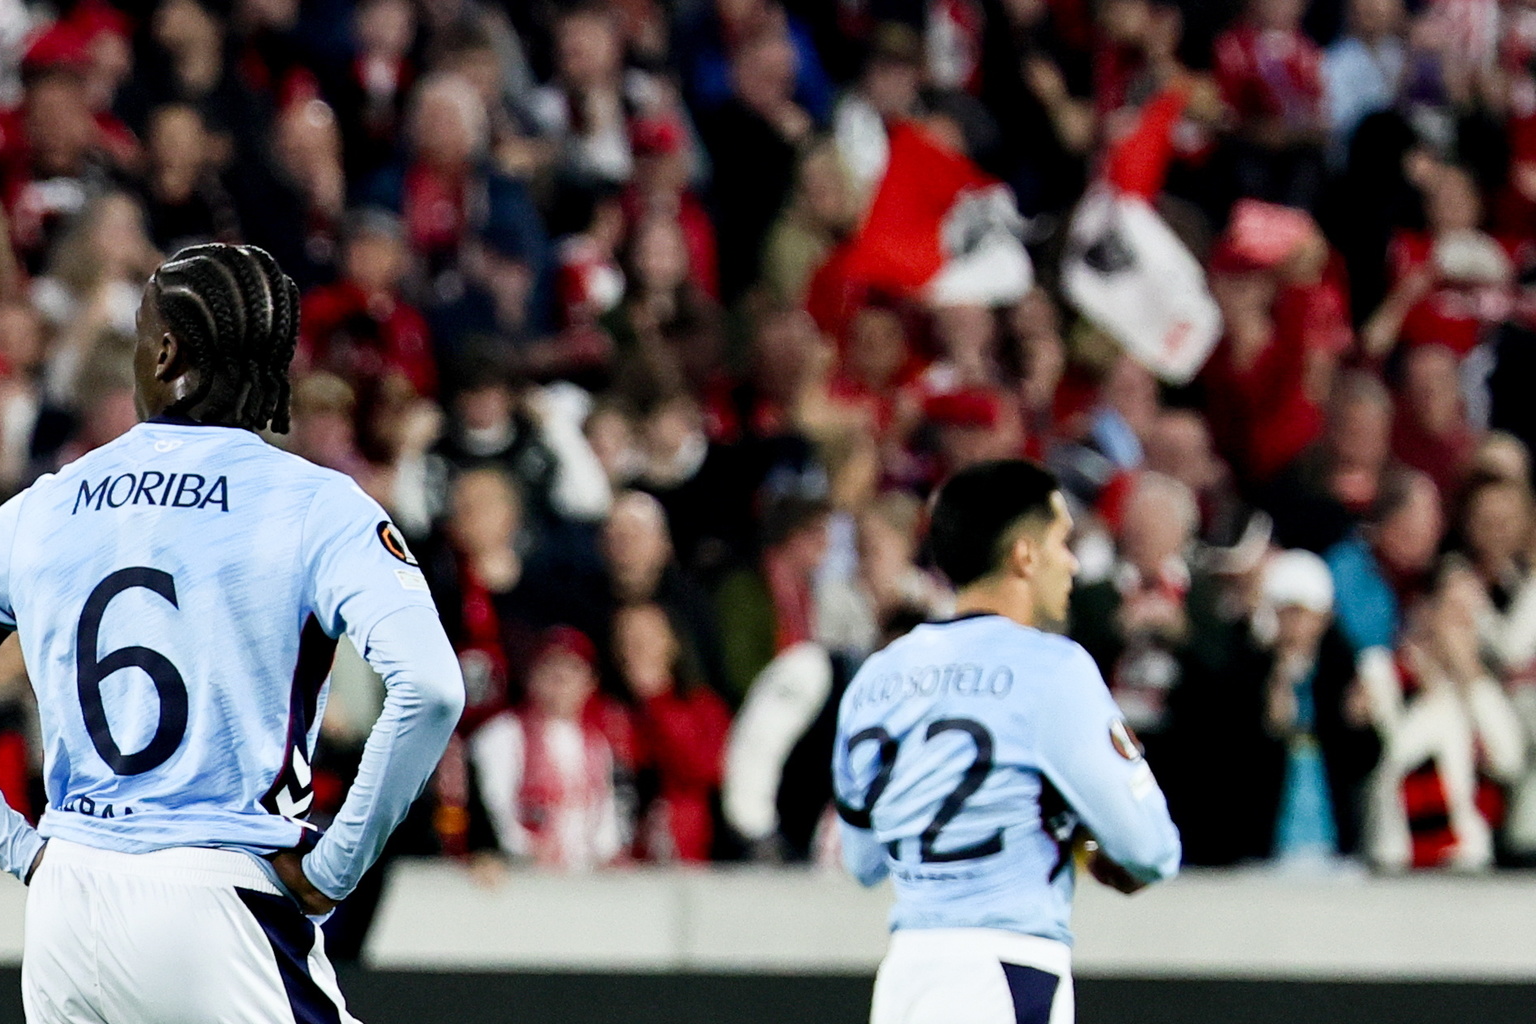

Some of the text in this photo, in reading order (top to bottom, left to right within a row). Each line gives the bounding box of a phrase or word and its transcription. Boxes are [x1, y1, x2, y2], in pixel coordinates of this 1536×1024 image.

[71, 471, 230, 515] MORIBA
[76, 566, 189, 776] 6
[847, 716, 1005, 864] 22
